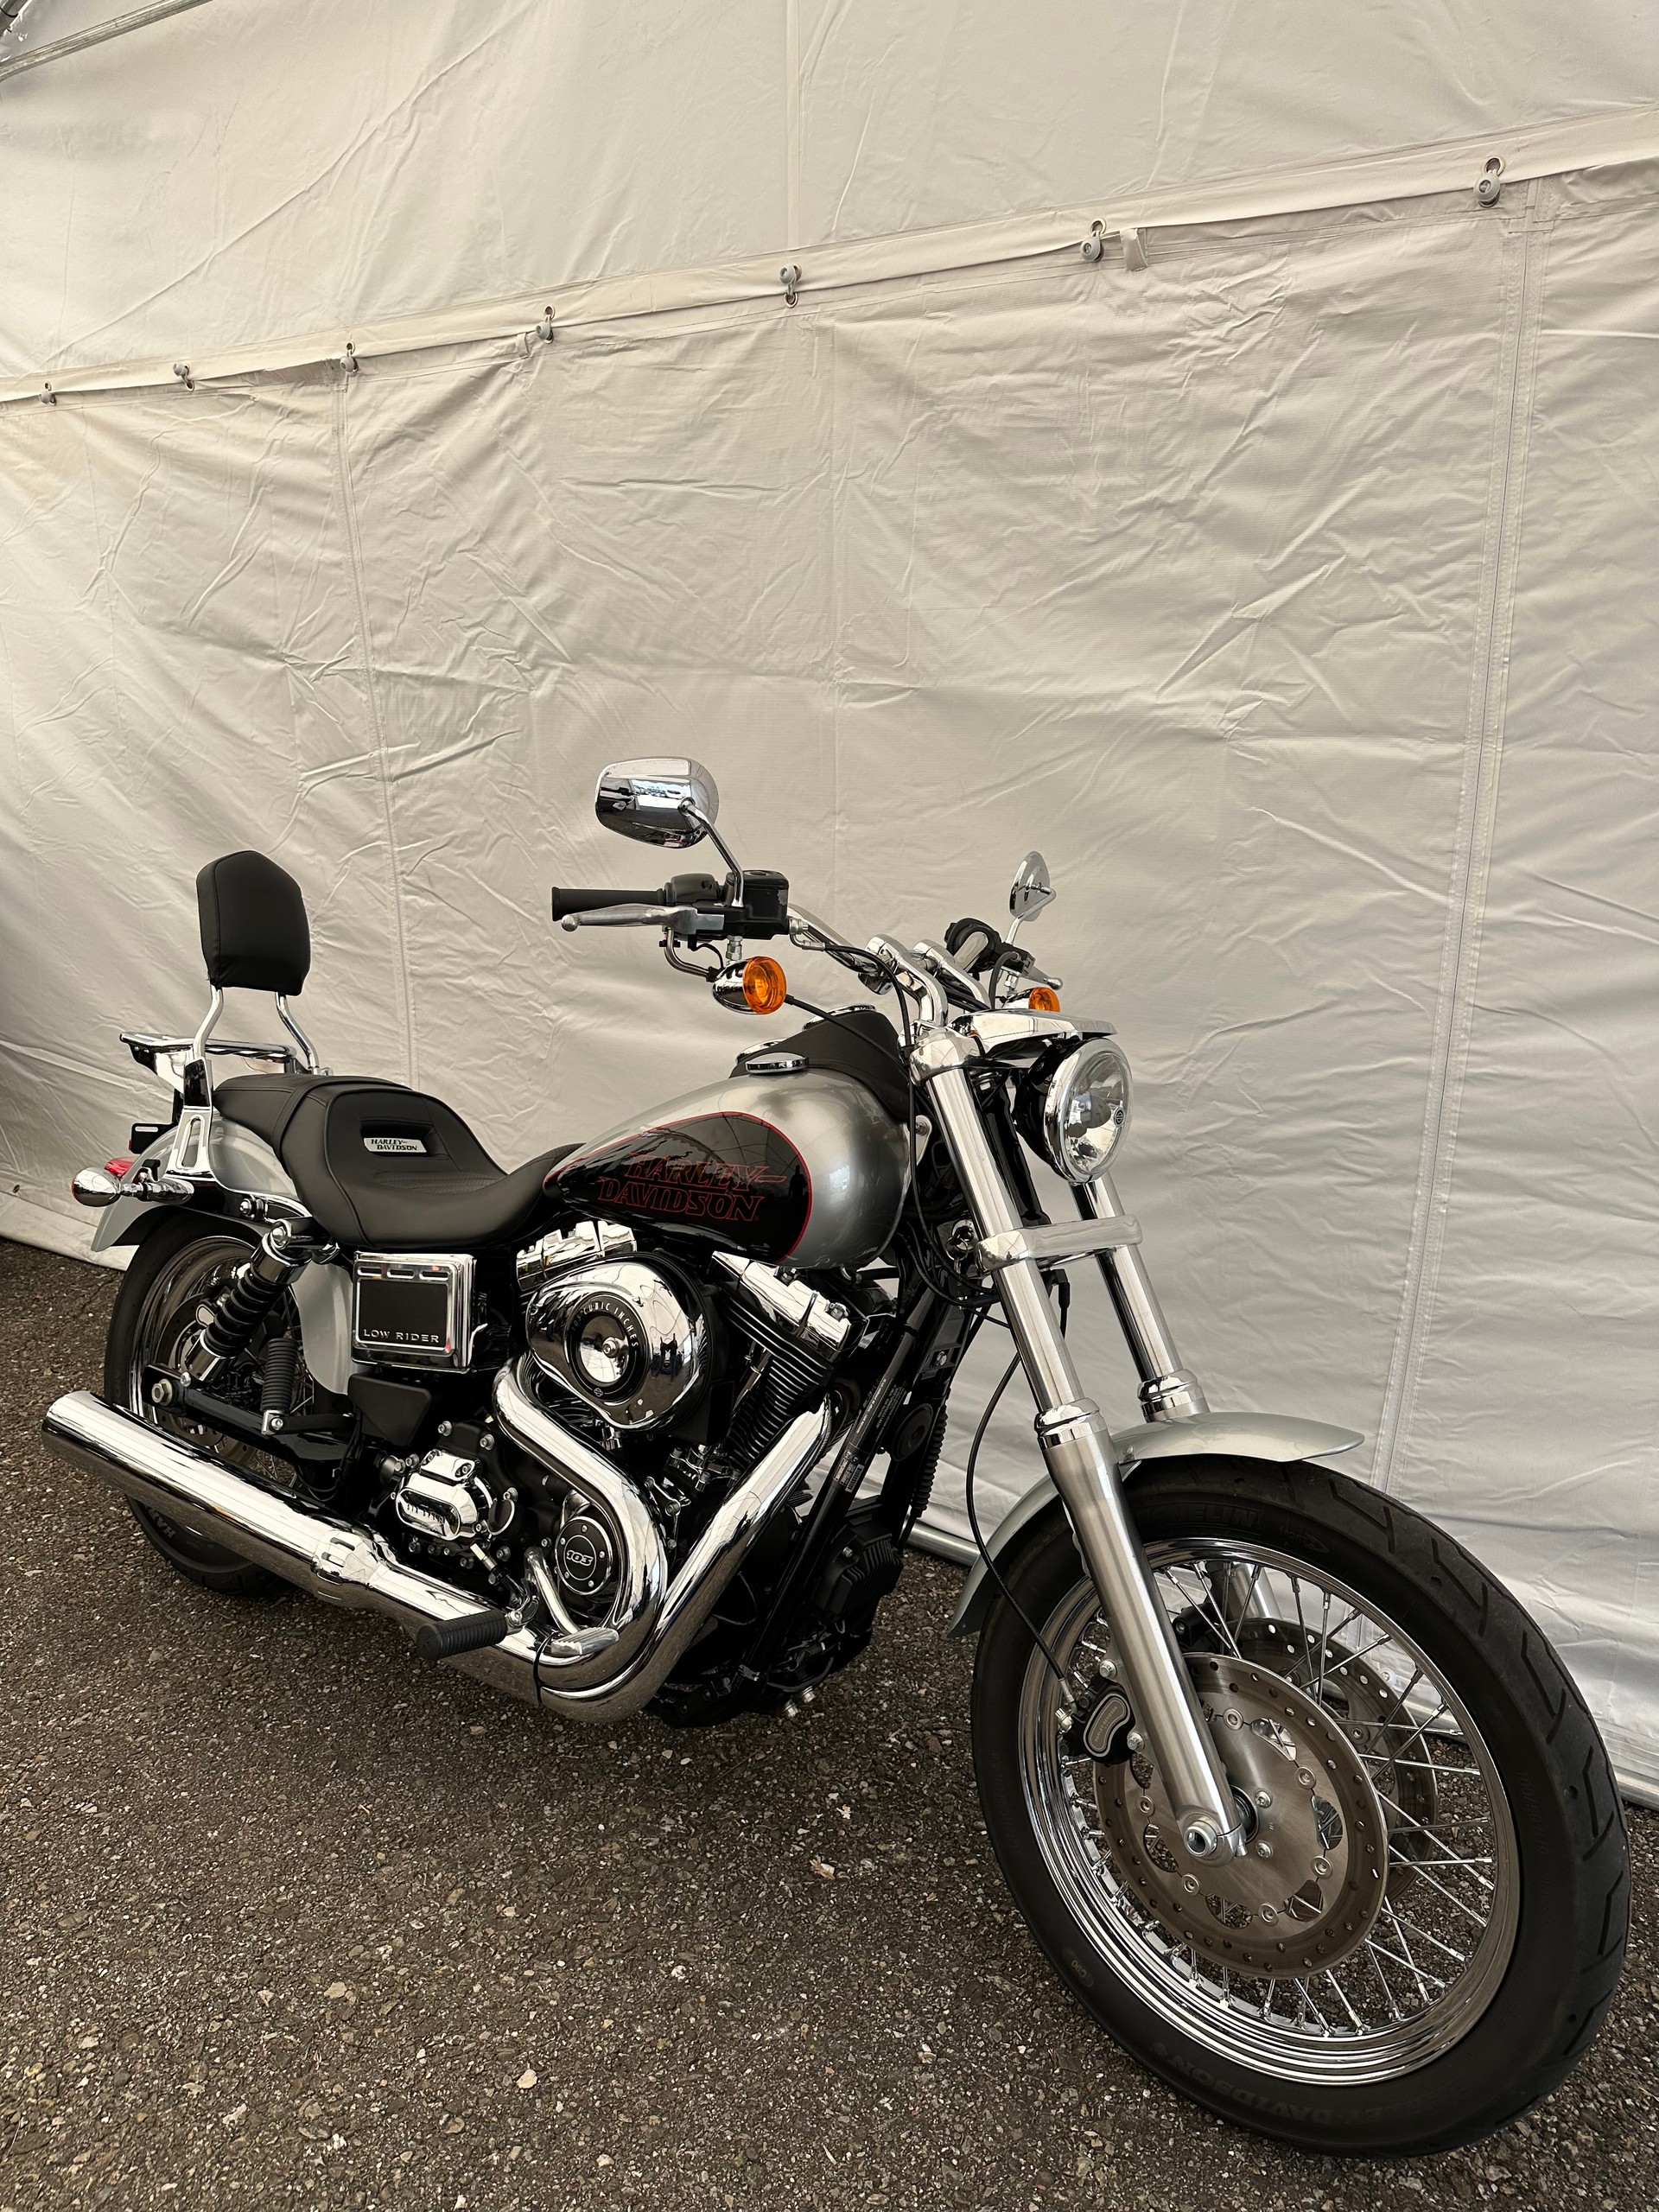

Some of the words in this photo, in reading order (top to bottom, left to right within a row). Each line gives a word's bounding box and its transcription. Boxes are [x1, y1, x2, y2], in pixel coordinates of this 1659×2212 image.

[624, 1154, 787, 1192] HARLEY-
[598, 1176, 765, 1222] DAVIDSON
[363, 1329, 391, 1339] LOW
[396, 1332, 440, 1344] RIDER
[583, 1302, 611, 1315] CUBIC
[613, 1306, 639, 1348] INCHES
[566, 1549, 594, 1567] 103
